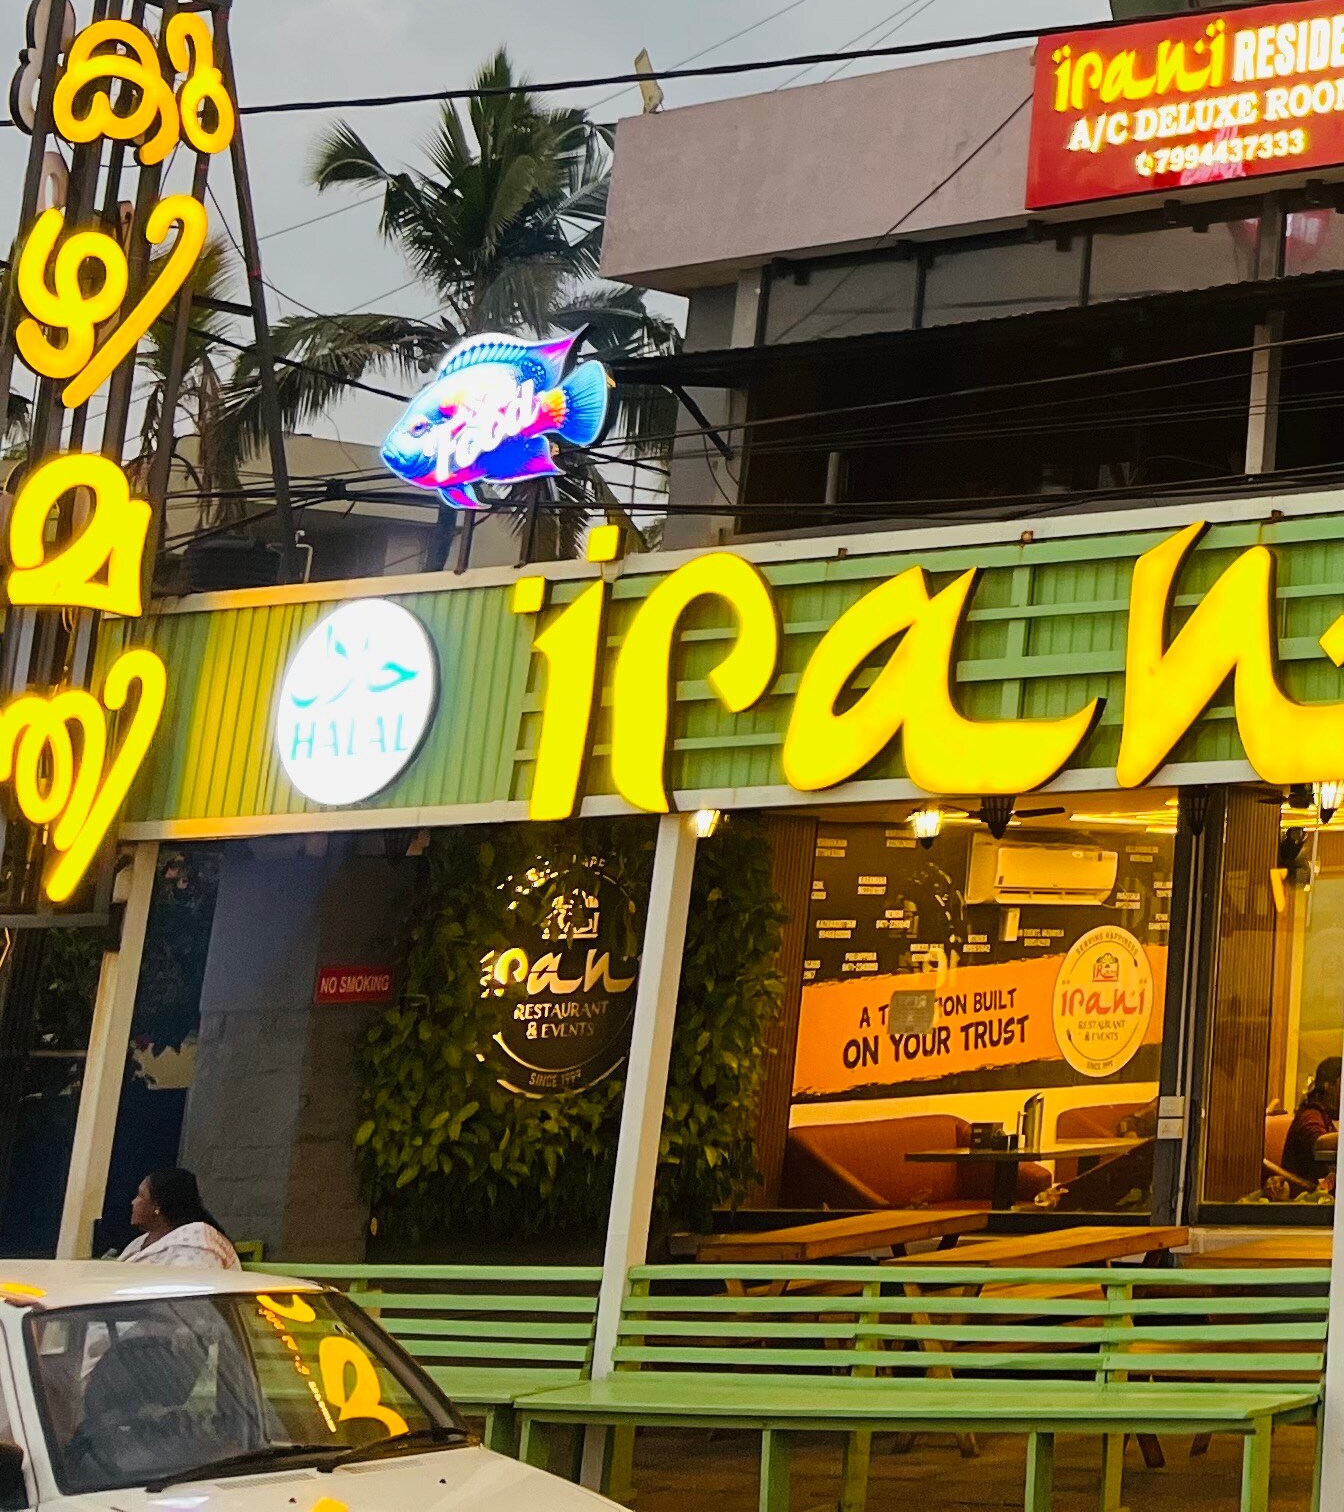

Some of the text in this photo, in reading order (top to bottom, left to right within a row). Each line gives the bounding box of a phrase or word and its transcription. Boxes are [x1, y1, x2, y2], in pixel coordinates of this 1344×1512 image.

[1067, 115, 1129, 153] A/C
[1133, 91, 1259, 142] DELUXE
[289, 712, 410, 762] HALAL
[320, 974, 390, 994] NO SMOKING
[513, 999, 609, 1021] RESTAURANT
[859, 1006, 871, 1029] A
[973, 988, 1017, 1013] BUILT
[526, 1021, 595, 1040] & EVENTS
[1078, 1019, 1126, 1030] RESTAURANT
[843, 1015, 1029, 1069] ON YOUR TRUST
[1091, 1031, 1119, 1041] EVENTS
[528, 1073, 558, 1088] SINCE
